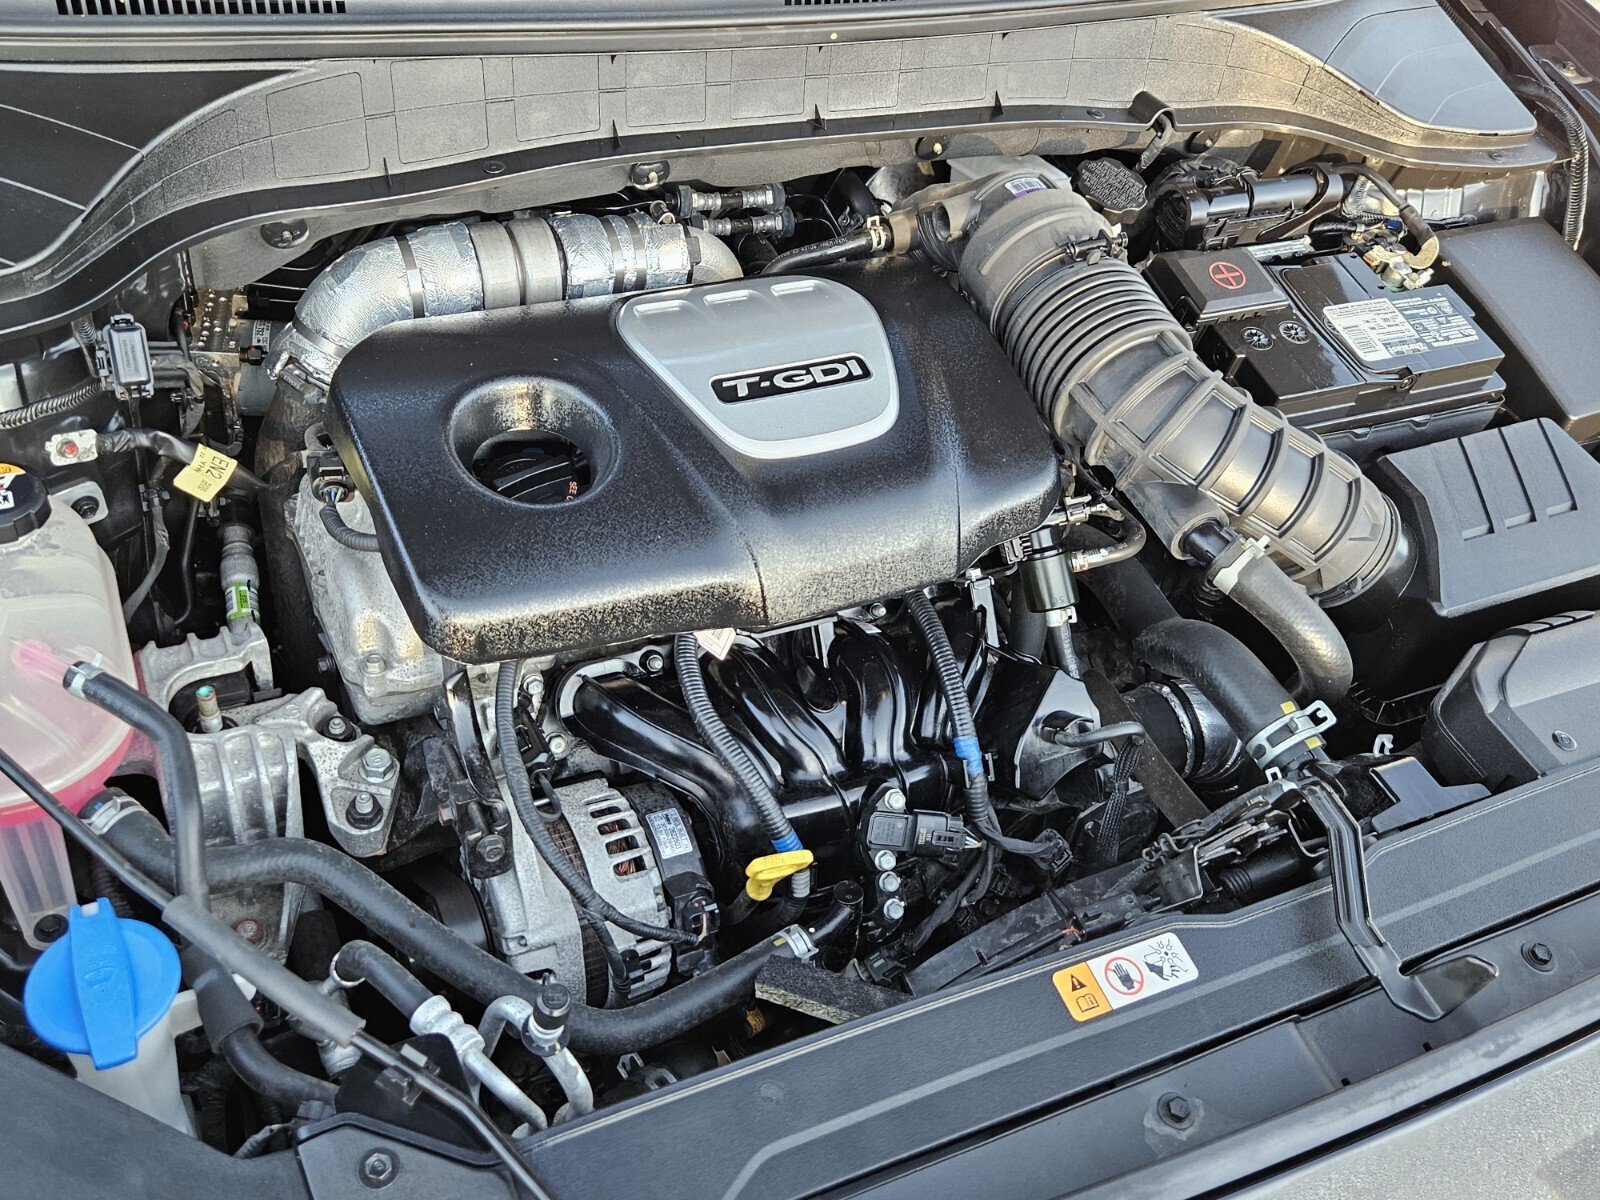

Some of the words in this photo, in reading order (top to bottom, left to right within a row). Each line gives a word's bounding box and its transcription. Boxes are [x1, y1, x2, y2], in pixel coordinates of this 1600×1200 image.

[722, 359, 863, 397] T-GDI
[206, 455, 230, 480] EN2
[569, 481, 577, 495] SEE
